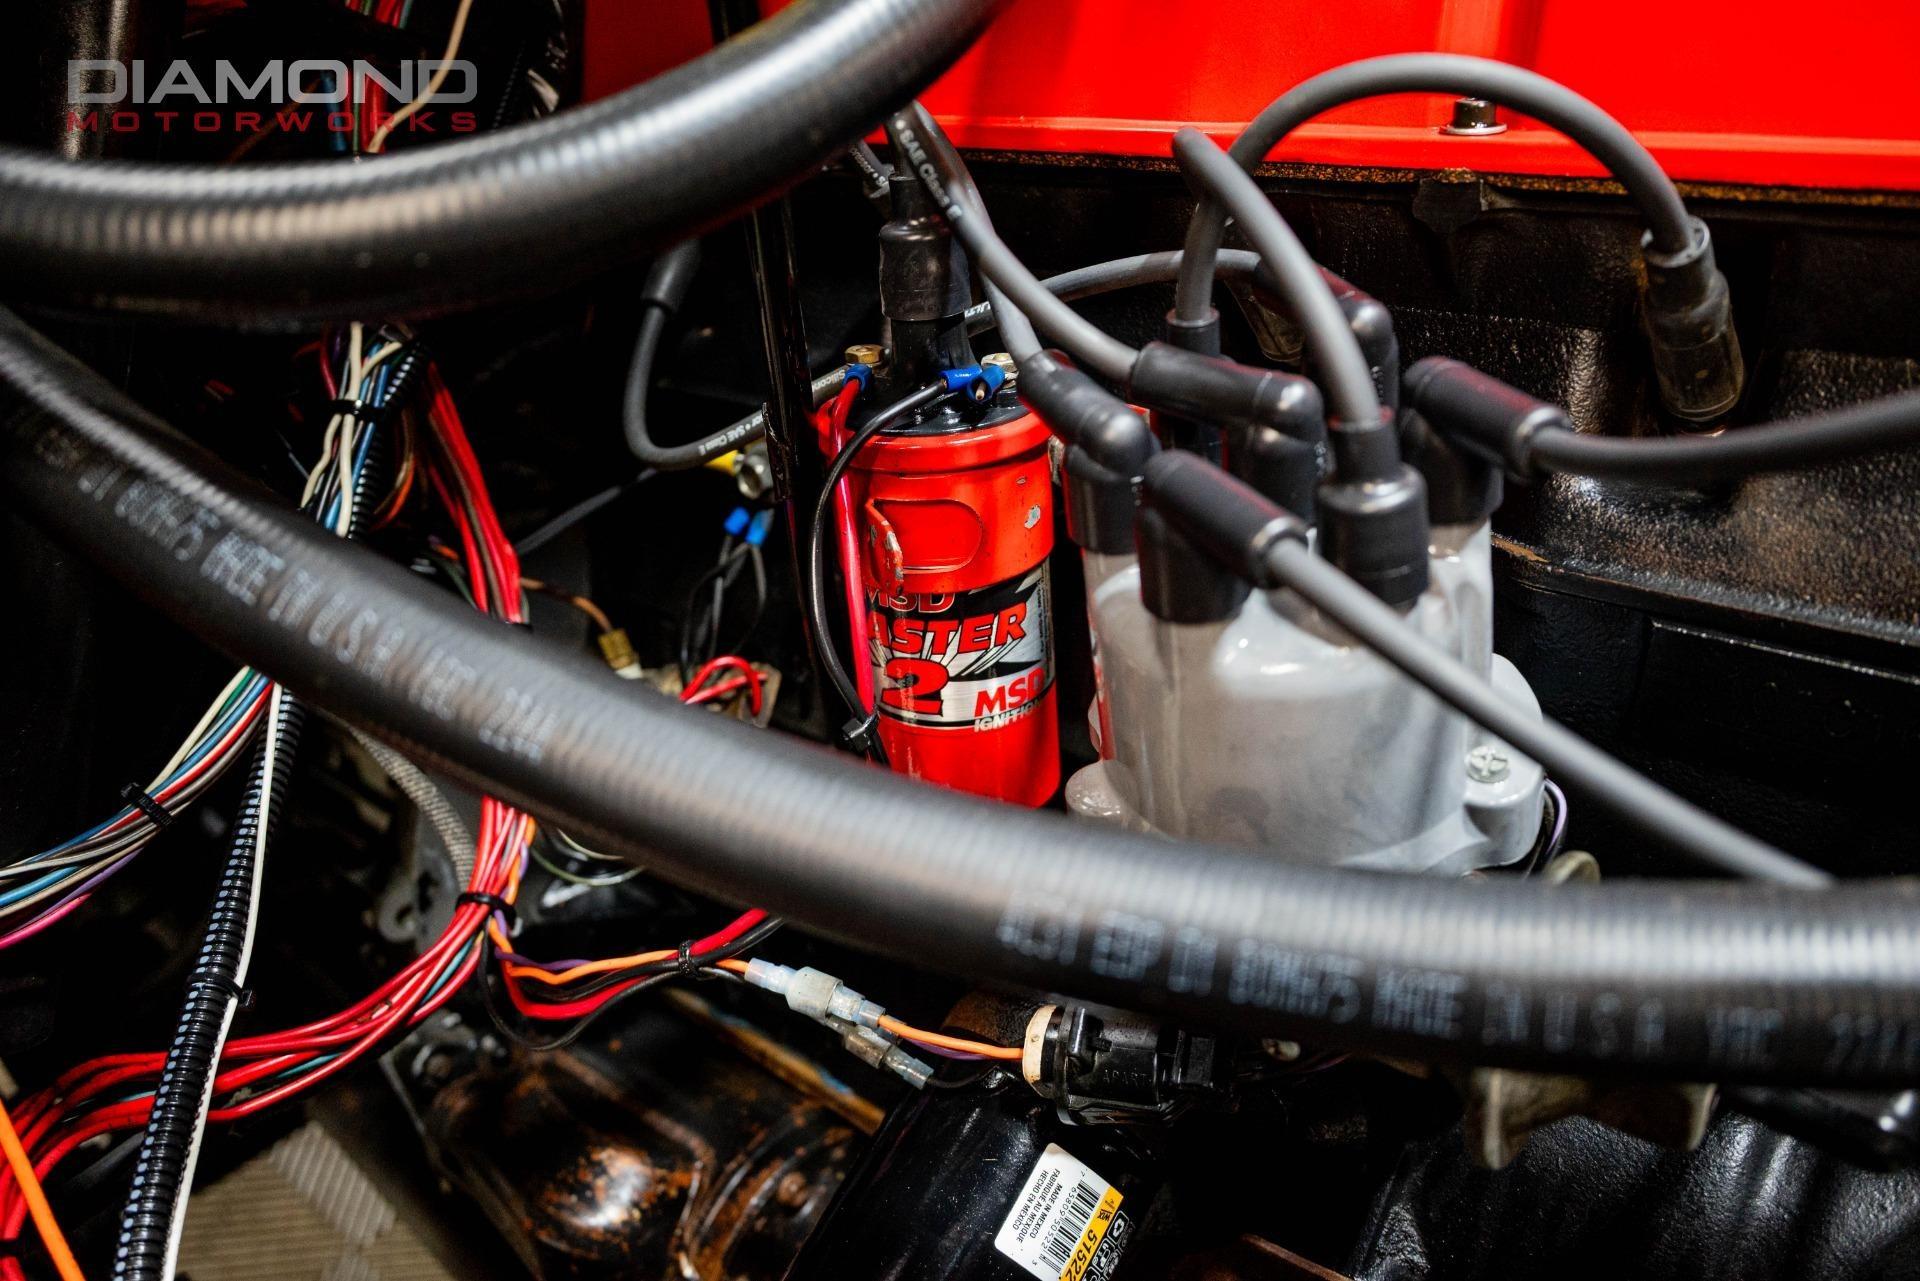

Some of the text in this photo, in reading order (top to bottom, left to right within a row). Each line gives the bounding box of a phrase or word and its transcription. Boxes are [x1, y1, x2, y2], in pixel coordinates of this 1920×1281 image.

[900, 129, 927, 166] SAE
[812, 369, 846, 393] Silicon
[866, 602, 1027, 656] ASTER
[881, 657, 949, 717] 2
[974, 667, 1045, 717] MSD
[1032, 1169, 1049, 1194] HECHO
[1027, 1193, 1037, 1204] EN
[1029, 1183, 1063, 1239] MADE IN MEXICO
[1033, 1202, 1043, 1213] AU
[1059, 1186, 1077, 1216] 65809
[1016, 1211, 1037, 1243] MEXIQUE
[1041, 1218, 1061, 1249] 50522
[1064, 1229, 1098, 1281] 51522
